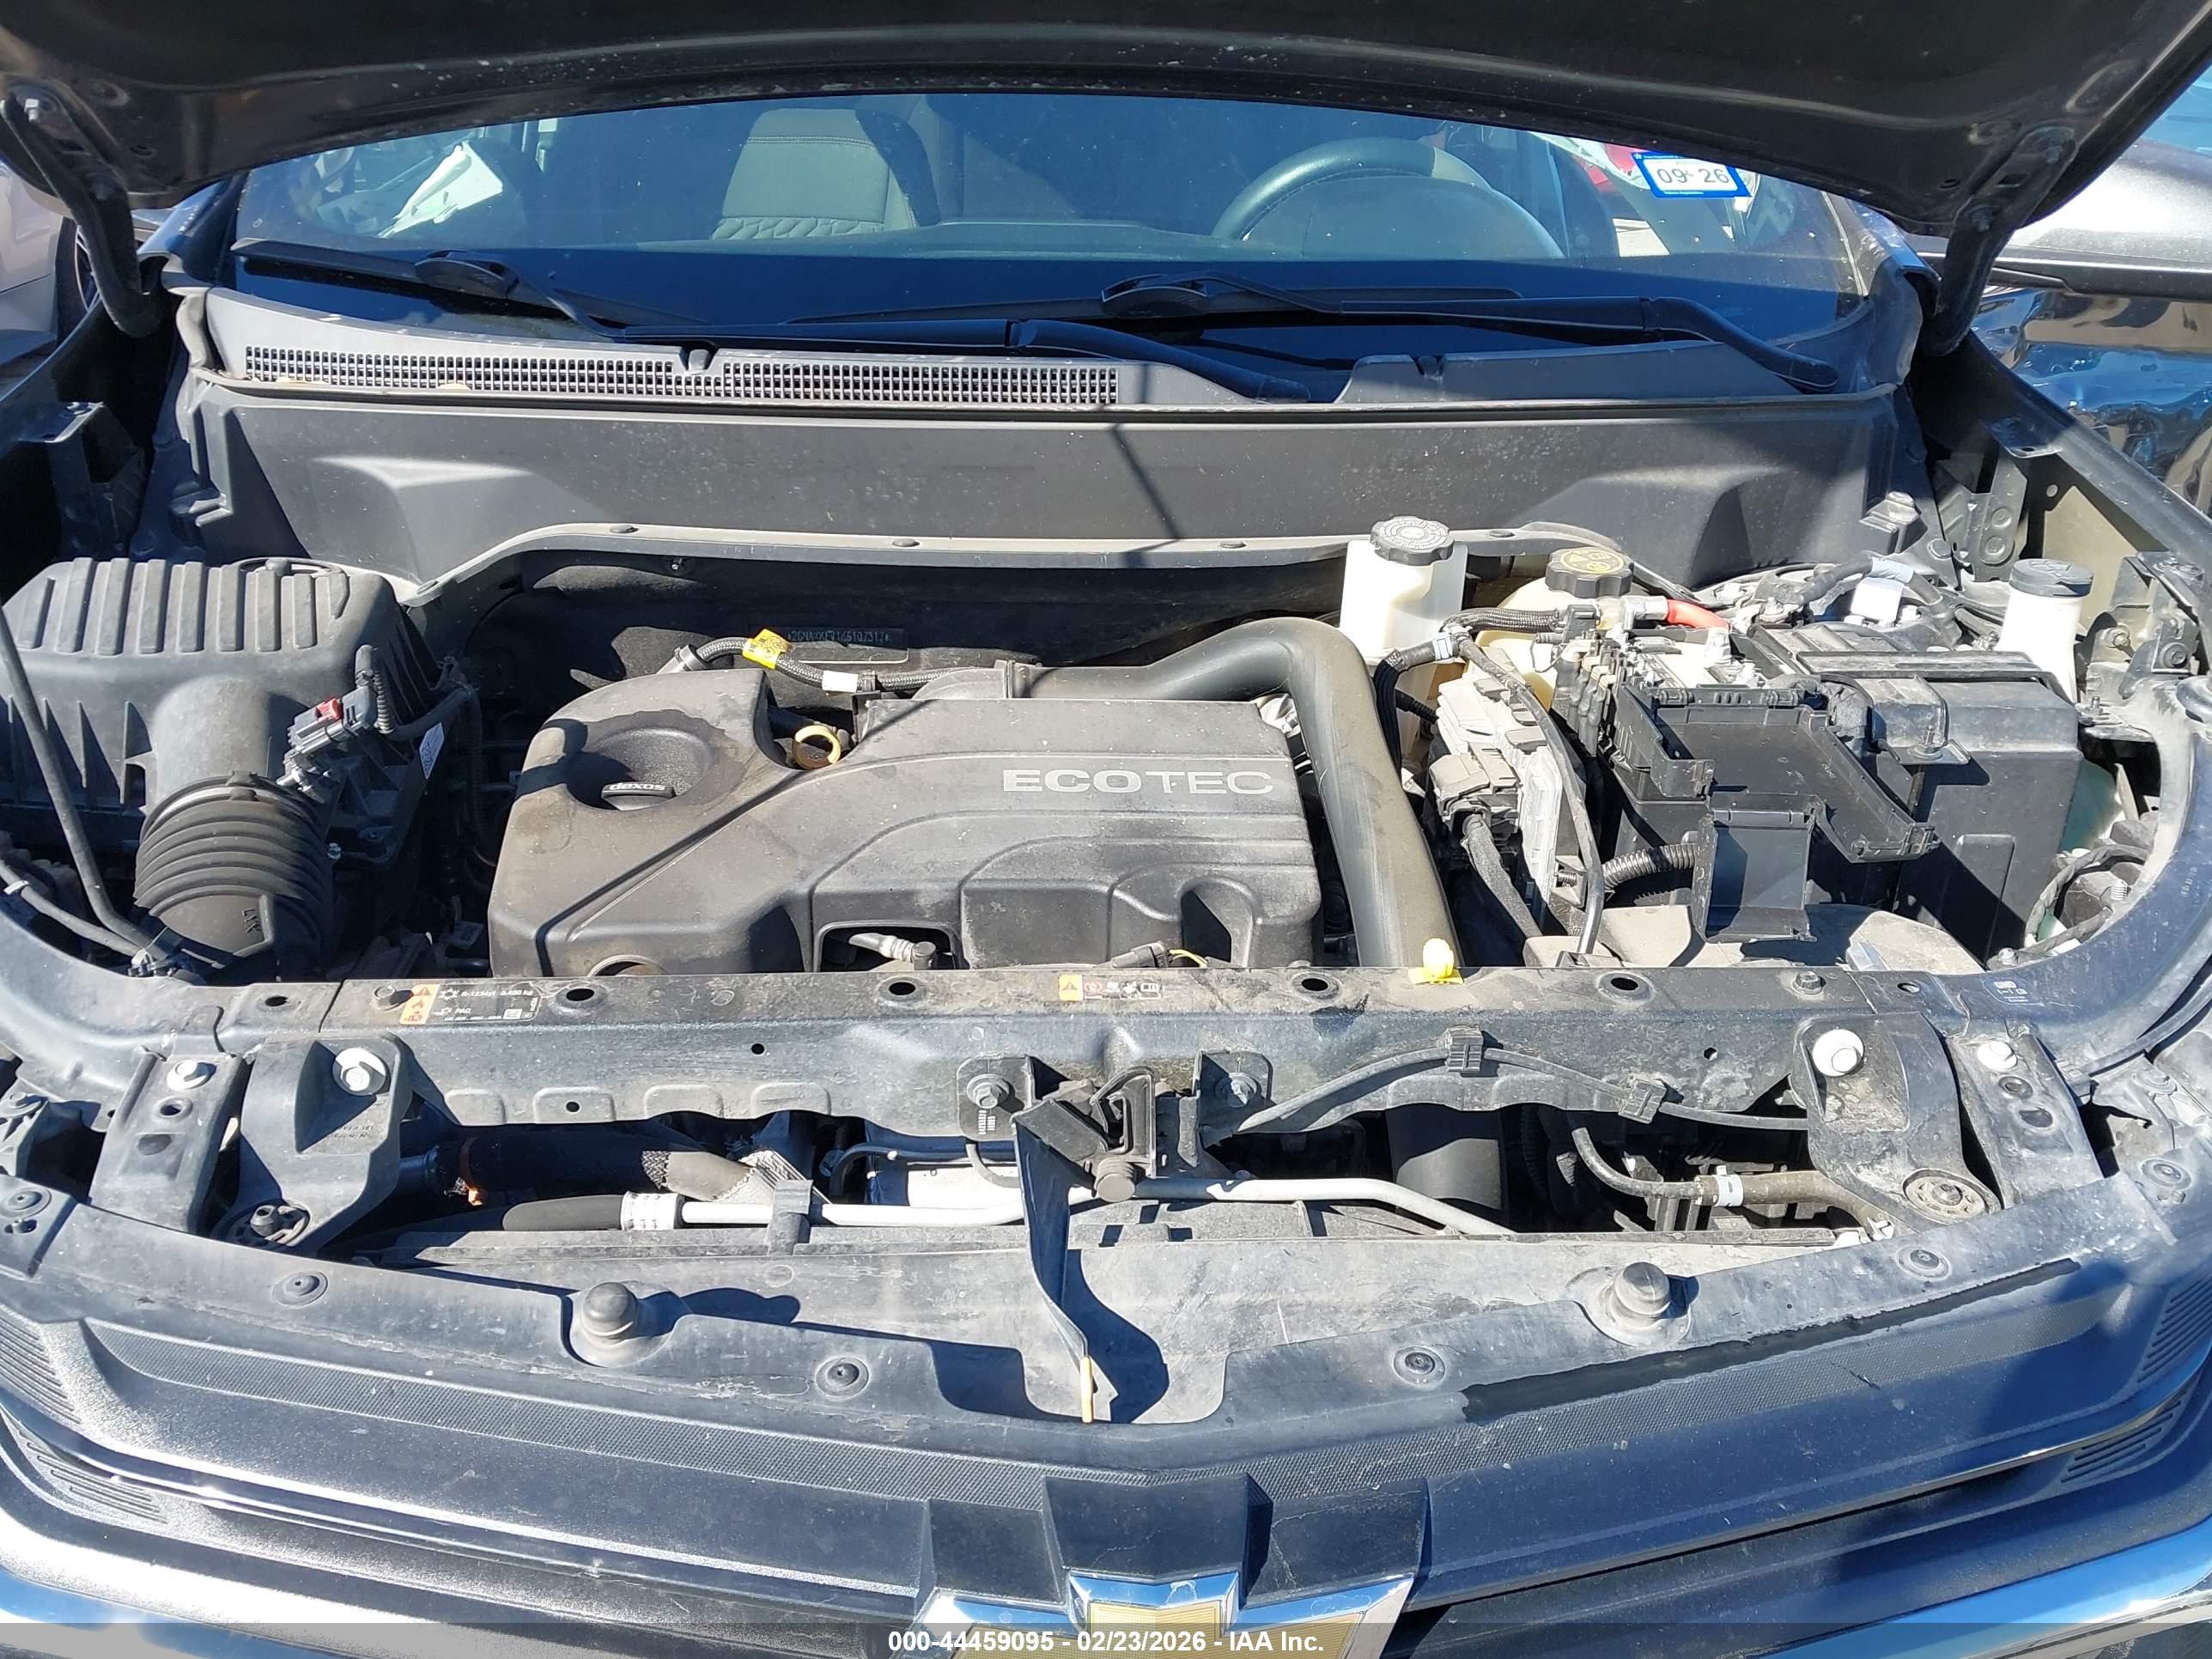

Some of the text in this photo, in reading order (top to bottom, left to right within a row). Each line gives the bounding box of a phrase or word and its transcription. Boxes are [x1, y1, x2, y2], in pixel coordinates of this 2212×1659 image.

[1656, 168, 1729, 184] 09 26
[609, 782, 665, 791] dexos
[1002, 769, 1274, 795] ECOTEC
